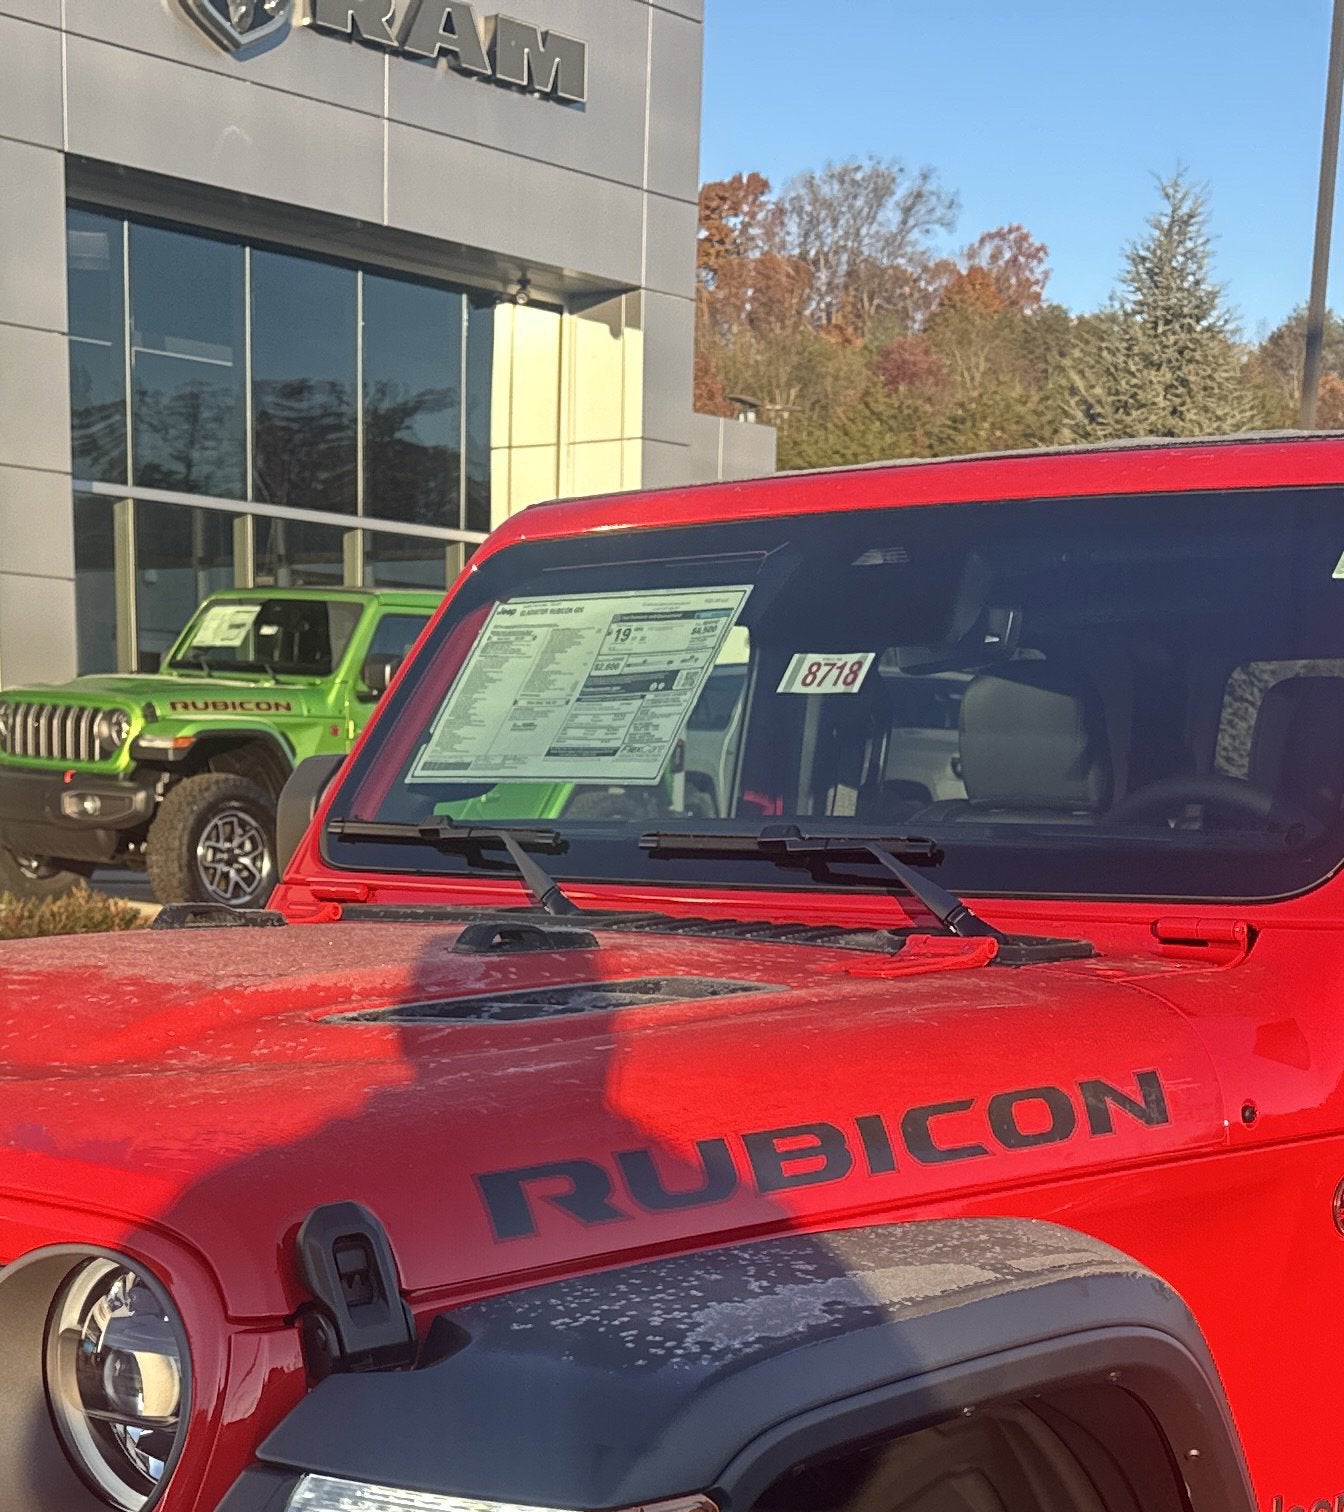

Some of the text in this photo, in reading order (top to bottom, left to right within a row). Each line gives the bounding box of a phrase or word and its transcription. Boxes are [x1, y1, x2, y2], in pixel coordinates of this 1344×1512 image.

[614, 628, 632, 642] 19
[801, 660, 863, 687] 8718
[170, 700, 292, 712] RUBICON
[477, 1068, 1170, 1243] RUBICON
